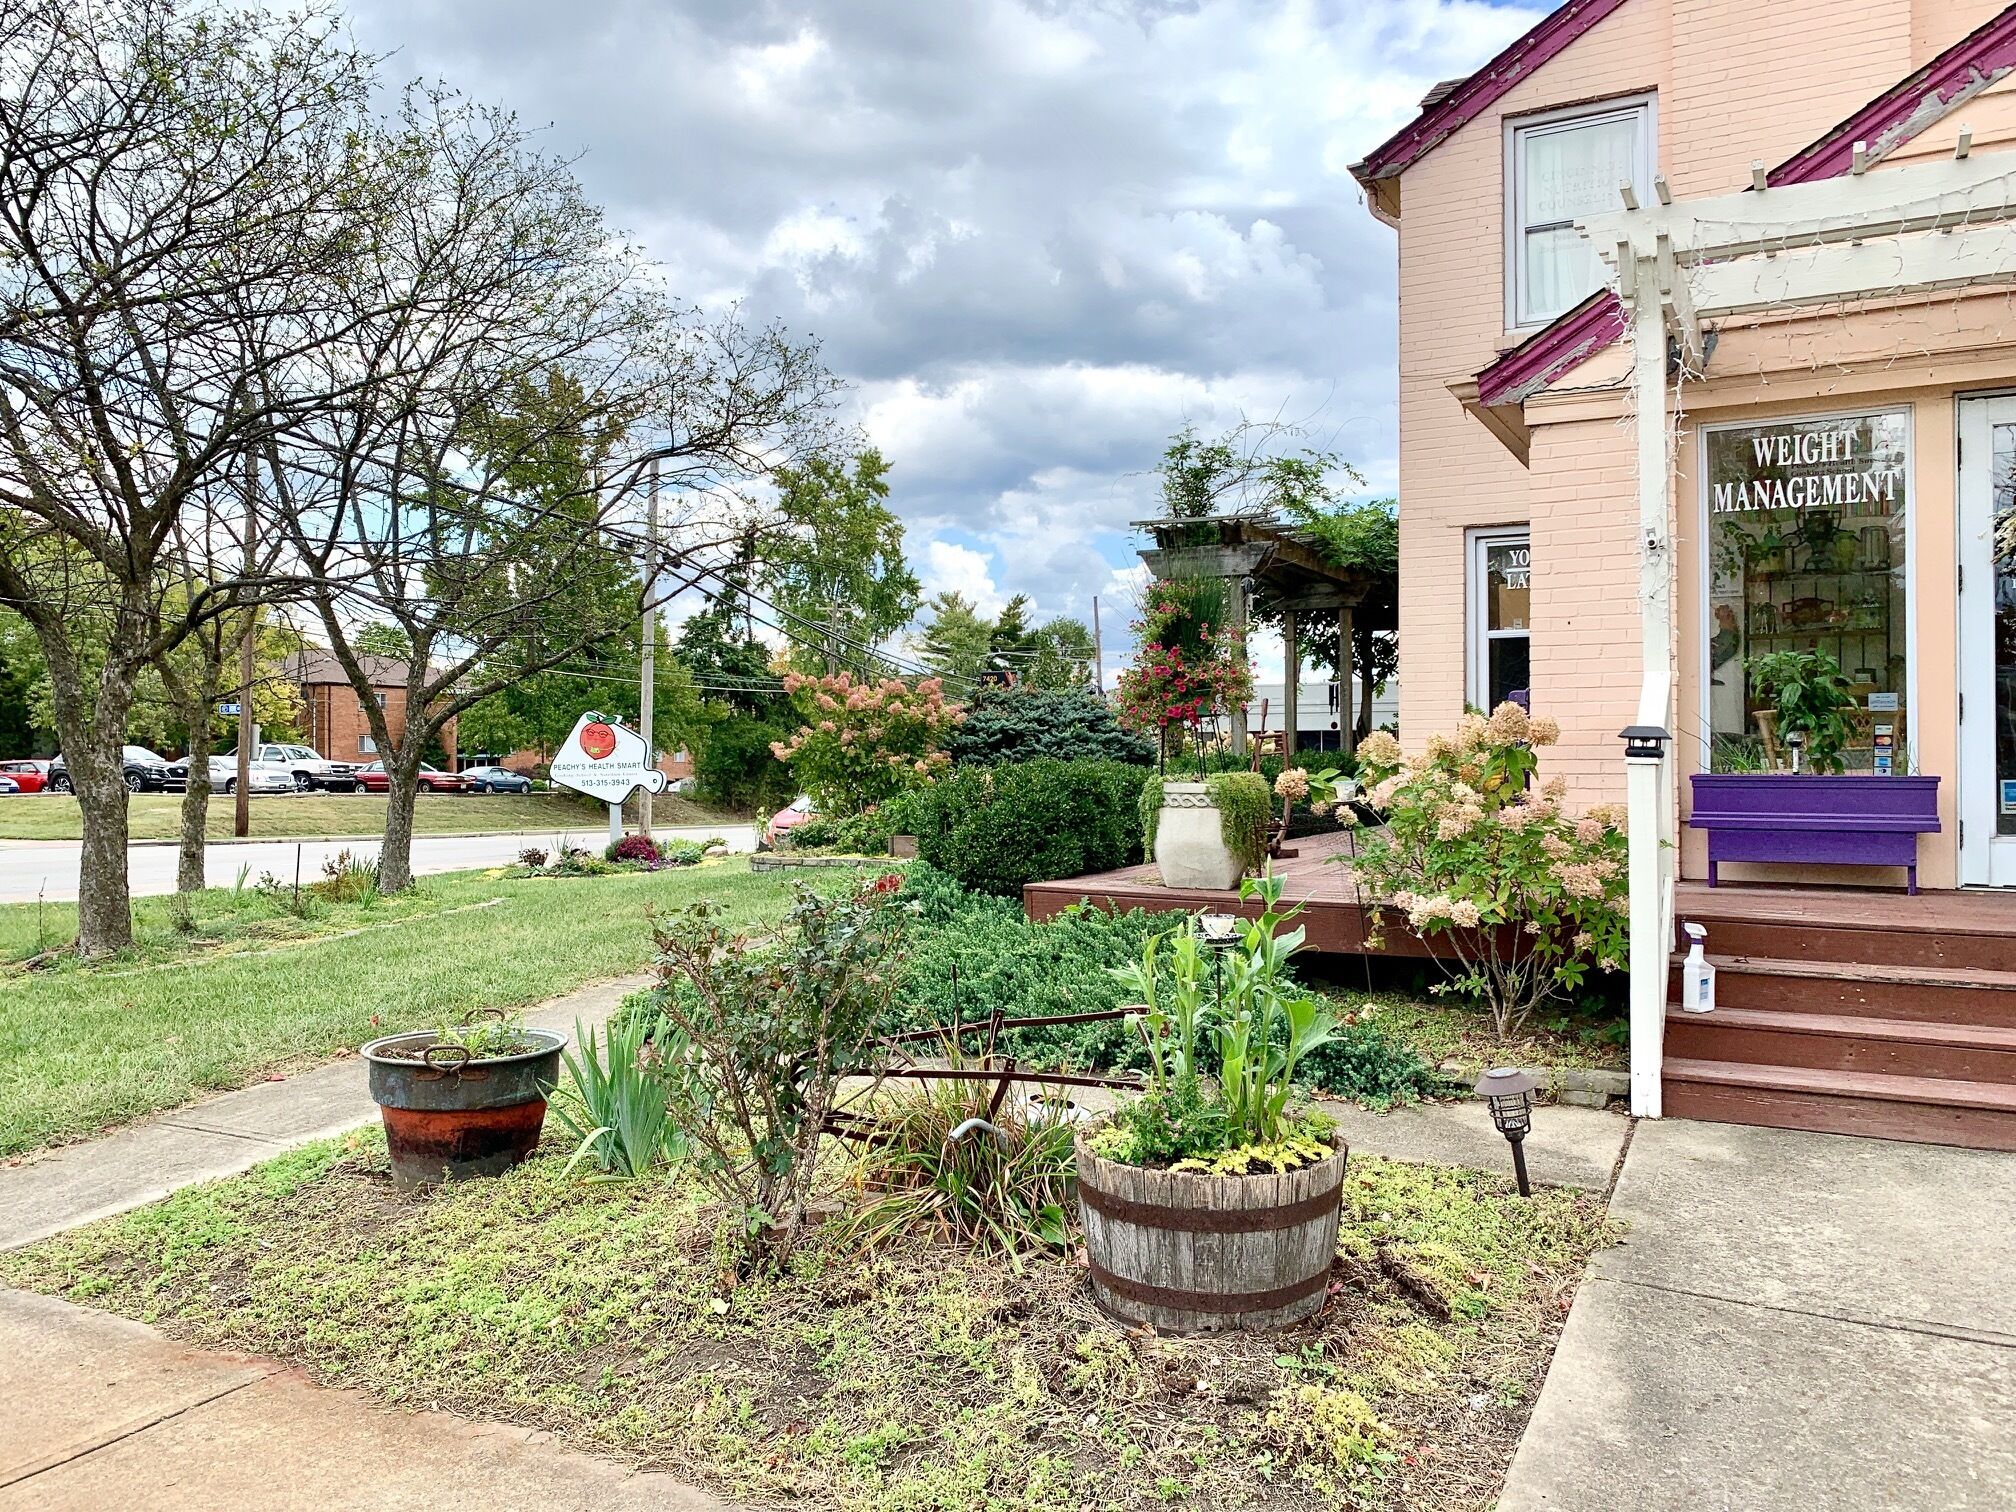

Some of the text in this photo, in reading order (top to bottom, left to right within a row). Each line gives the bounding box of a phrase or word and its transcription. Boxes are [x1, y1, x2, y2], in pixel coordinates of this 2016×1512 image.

[1752, 430, 1858, 468] WEIGHT
[1713, 470, 1900, 513] MANAGEMENT
[553, 762, 641, 771] PEACHY'S HEALTH SMART
[581, 779, 630, 787] 513-315-3943
